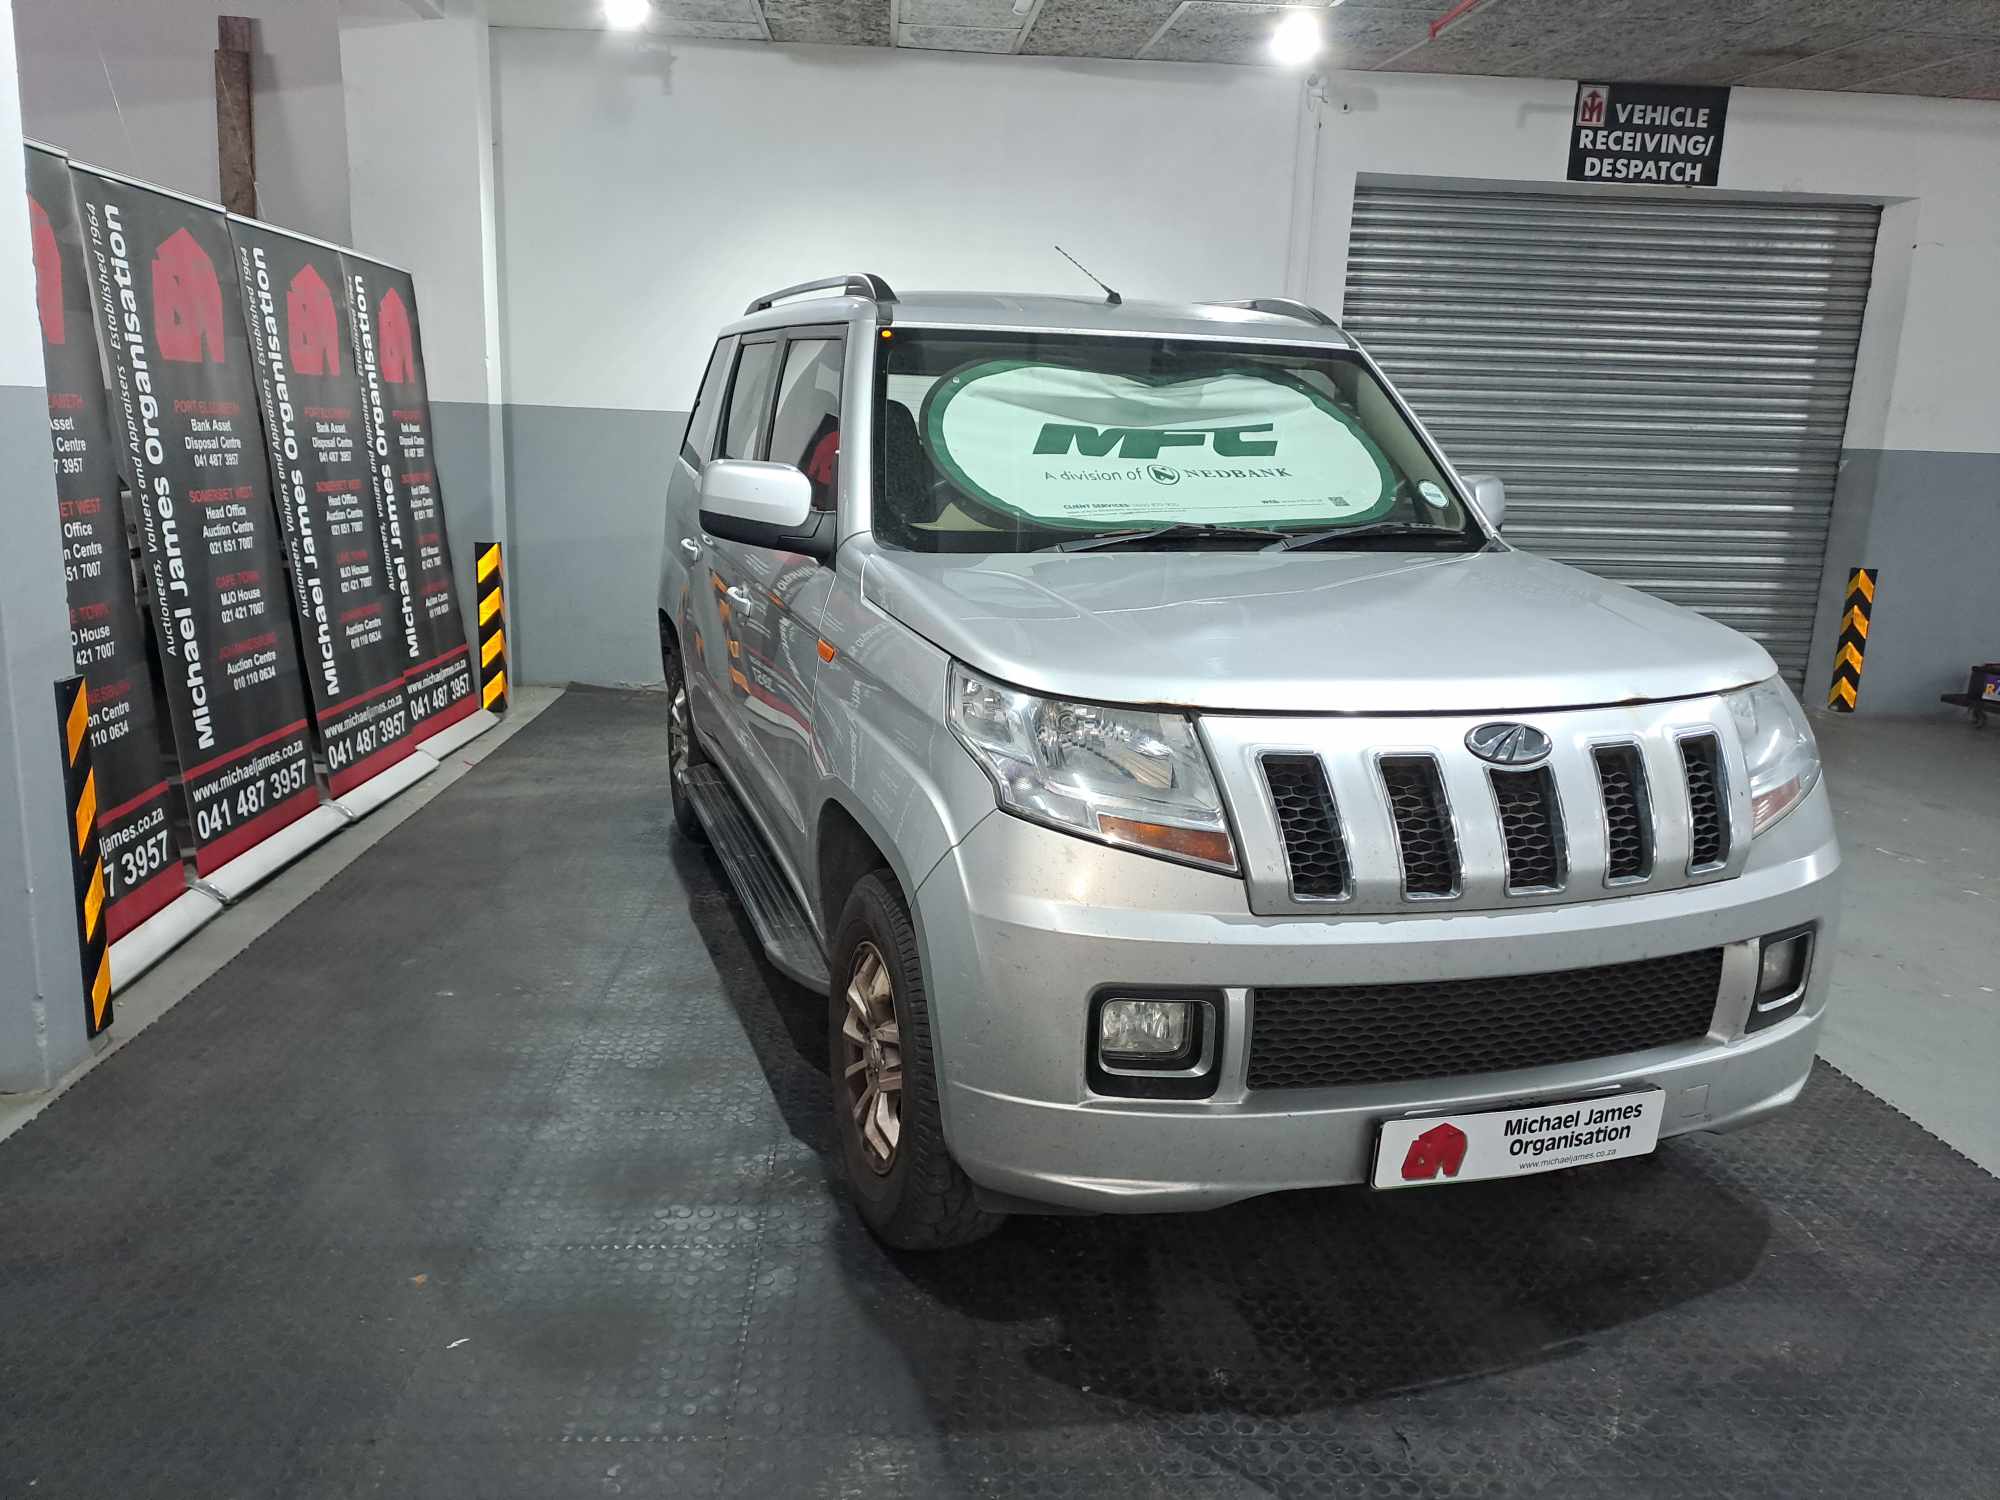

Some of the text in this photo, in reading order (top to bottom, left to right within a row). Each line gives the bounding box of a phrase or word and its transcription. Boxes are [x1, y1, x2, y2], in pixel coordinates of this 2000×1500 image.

[1616, 103, 1710, 128] VEHICLE
[1579, 129, 1715, 157] RECEIVING/
[1583, 156, 1703, 183] DESPATCH
[86, 202, 102, 245] 1964
[94, 250, 121, 350] Established
[246, 285, 266, 366] Established
[117, 365, 140, 453] Appraisers
[263, 378, 281, 450] Appraisers
[191, 418, 232, 432] Bank Asset
[56, 437, 87, 452] Centre
[184, 436, 219, 452] Disposal
[1032, 423, 1278, 459] MFC
[62, 457, 83, 474] 3957
[132, 456, 146, 489] and
[194, 454, 207, 467] 041
[209, 454, 222, 466] 487
[253, 247, 340, 696] Michael James Organisation
[273, 452, 286, 479] and
[355, 275, 420, 658] Michael James Organisation
[1045, 467, 1143, 481] A division of
[1184, 467, 1293, 480] NEDBANK
[104, 204, 214, 750] Michael James Organisation
[206, 504, 246, 519] Head Office
[281, 483, 295, 532] Valuers
[64, 522, 93, 538] Office
[141, 493, 157, 553] Valuers
[203, 521, 254, 538] Auction Centre
[73, 541, 103, 559] Centre
[66, 561, 101, 581] 51 7007
[153, 560, 177, 657] Auctioneers,
[221, 588, 261, 606] MJO House
[235, 607, 248, 620] 421
[80, 625, 111, 643] House
[76, 641, 115, 665] 421 7007
[227, 650, 277, 675] Auction Centre
[410, 673, 470, 721] 041 487 3957
[102, 701, 130, 721] Centre
[91, 729, 107, 747] 110
[109, 720, 129, 740] 0634
[328, 711, 406, 770] 041 487 3957
[192, 740, 304, 802] www.michaeljames.co.za
[197, 758, 307, 839] 041 487 3957
[99, 807, 164, 860] ljames.co.za
[121, 829, 168, 885] 3957
[1503, 1104, 1643, 1137] Michael James
[1509, 1125, 1632, 1156] Organisation
[1519, 1149, 1617, 1170] www.michaeljames.co.za
